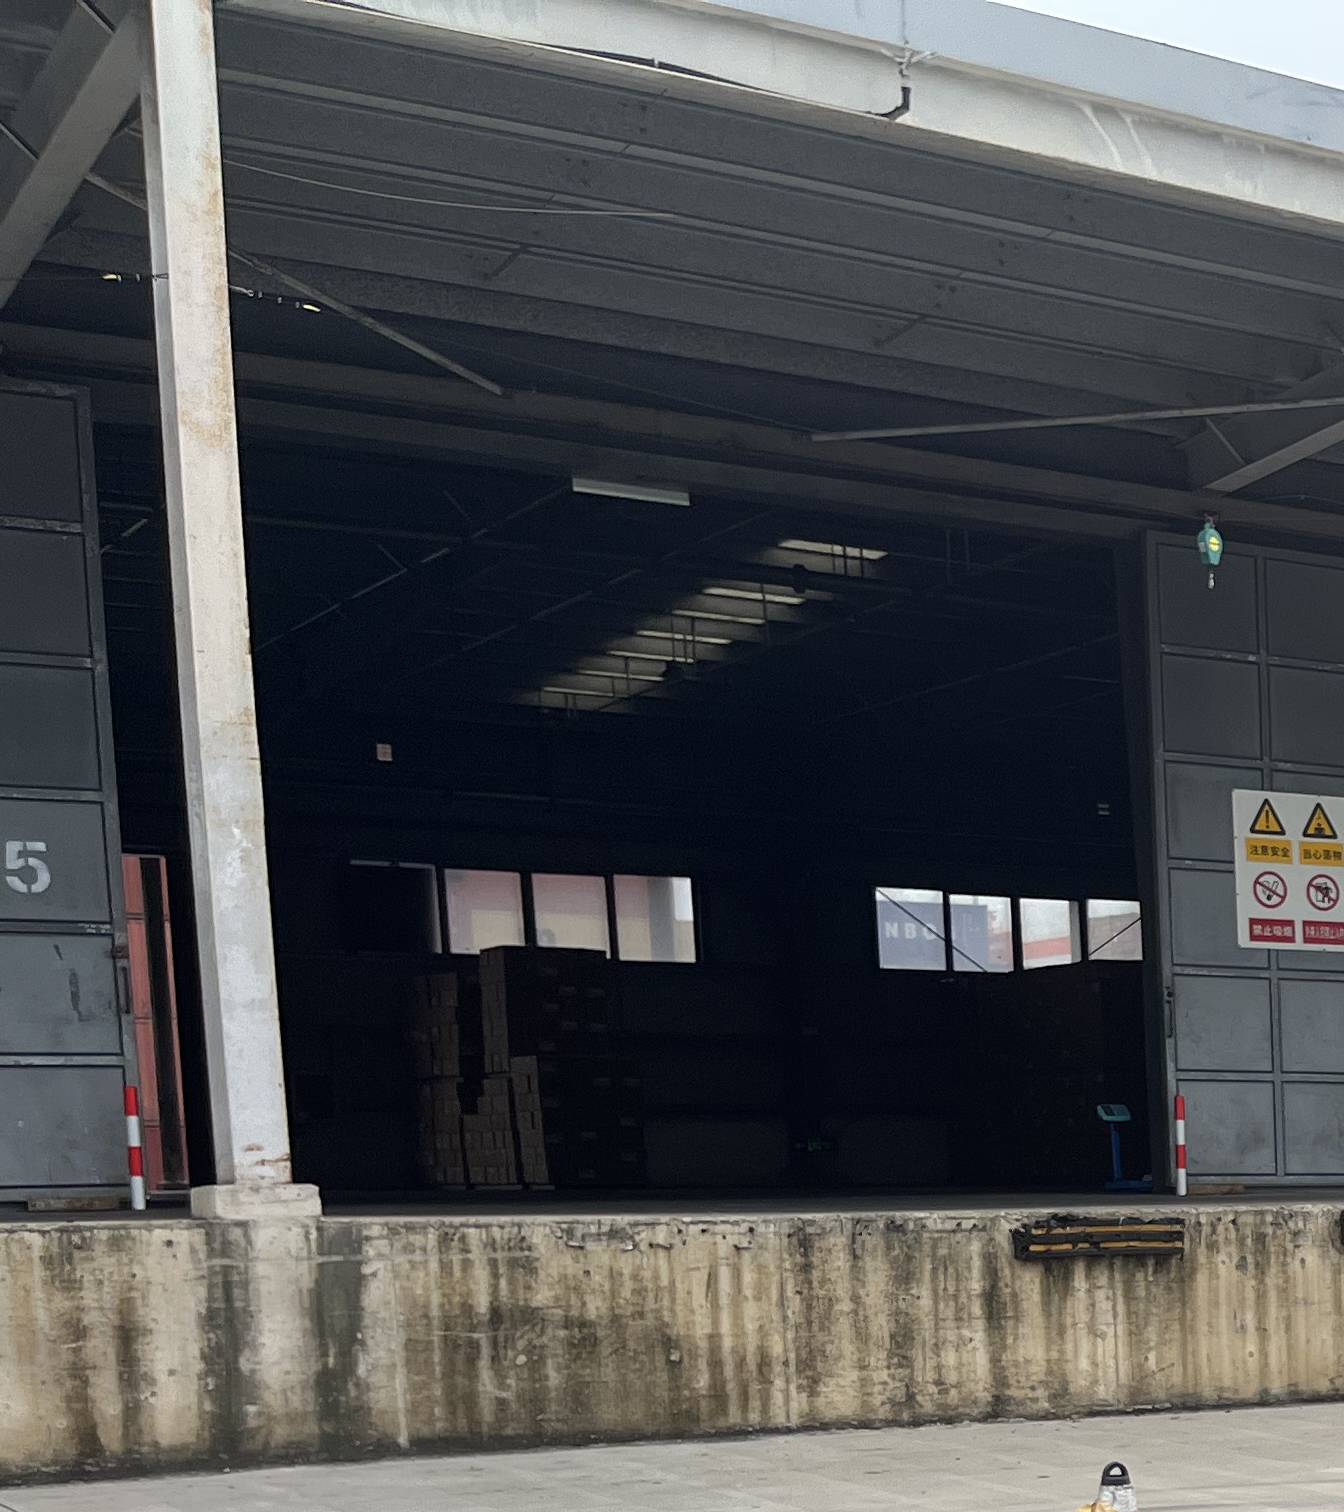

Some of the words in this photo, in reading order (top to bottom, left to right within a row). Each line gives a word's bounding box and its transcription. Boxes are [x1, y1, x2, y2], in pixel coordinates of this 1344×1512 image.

[1250, 844, 1291, 858] 注意安全
[5, 841, 51, 894] 5
[1252, 924, 1294, 937] 禁止吸烟
